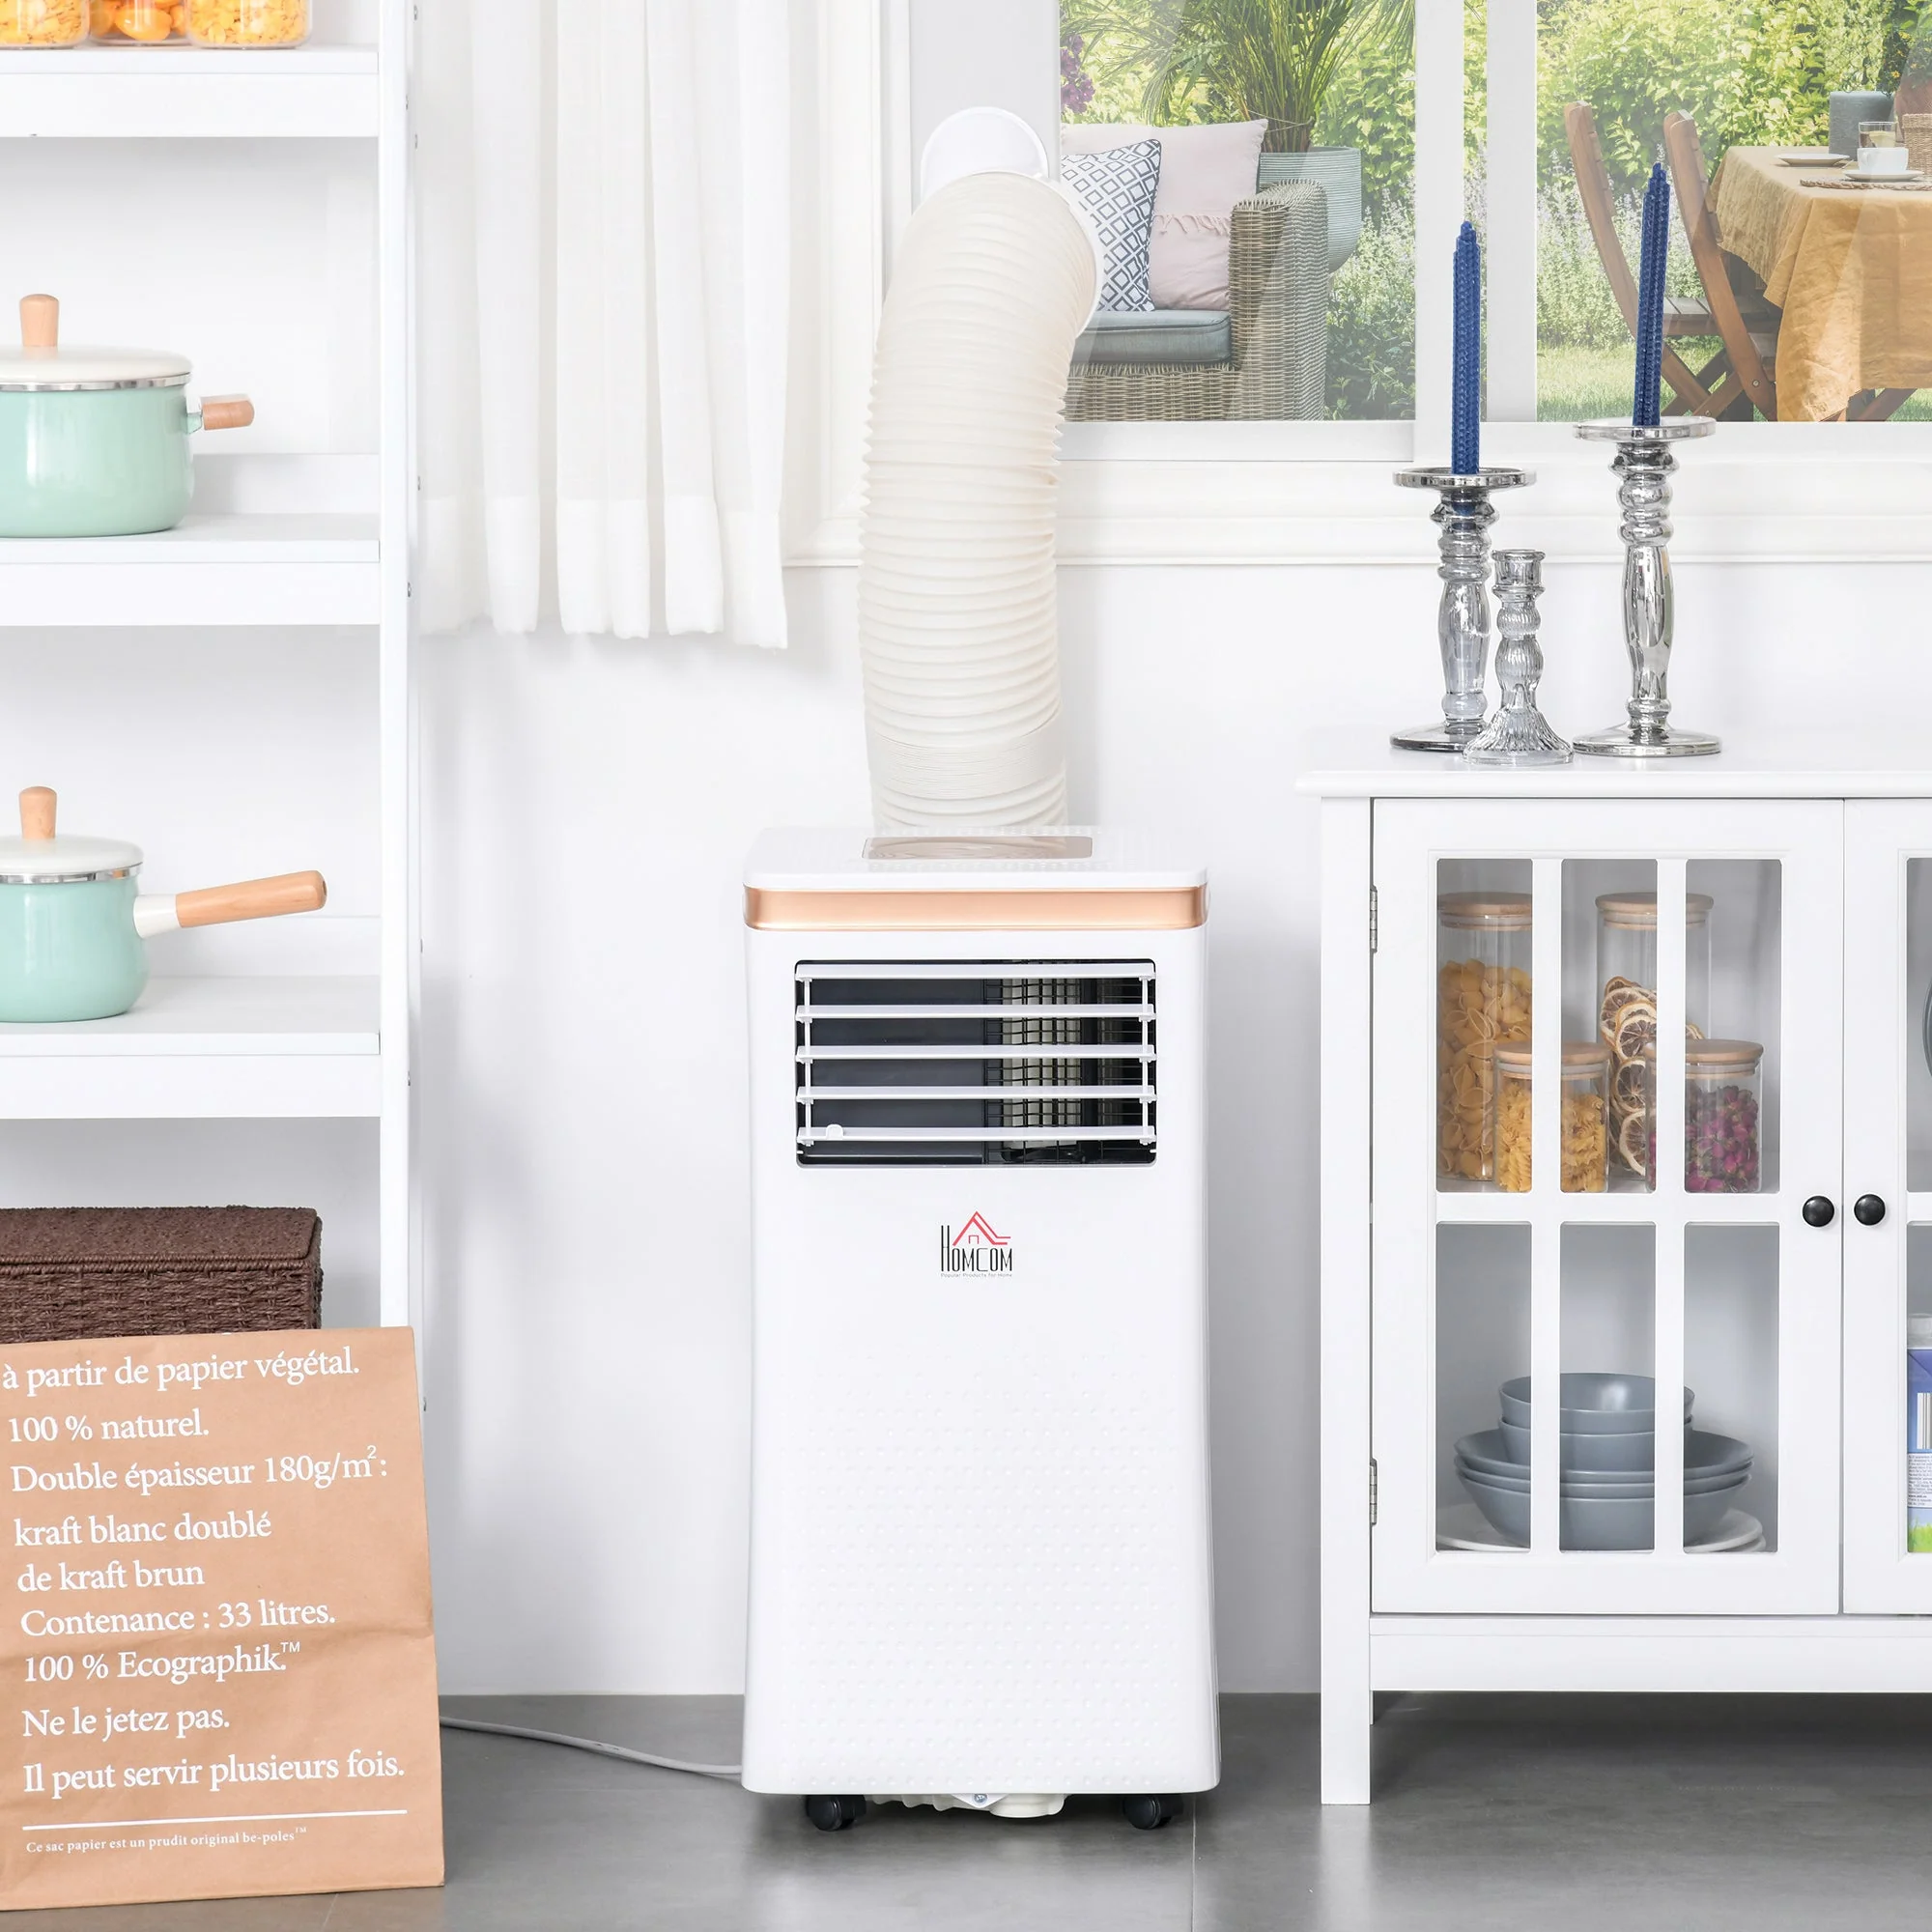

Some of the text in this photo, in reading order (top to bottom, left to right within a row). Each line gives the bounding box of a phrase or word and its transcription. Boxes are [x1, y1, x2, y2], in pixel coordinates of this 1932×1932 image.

[2, 1345, 360, 1398] à partir de papier végétal.
[9, 1407, 210, 1442] 100 % naturel.
[10, 1462, 118, 1492] Double
[125, 1461, 256, 1496] épaisseur
[14, 1509, 271, 1547] kraft blanc doublé
[16, 1559, 206, 1592] de kraft brun
[20, 1609, 195, 1636] Contenance
[217, 1602, 252, 1629] 33
[258, 1598, 336, 1627] litres.
[25, 1655, 73, 1682] 100
[82, 1654, 109, 1680] %
[21, 1706, 230, 1743] Ne le jetez pas.
[23, 1747, 405, 1800] Il peut servir plusieurs fois.
[26, 1842, 43, 1853] Ce
[45, 1842, 65, 1852] sac
[67, 1839, 107, 1854] papier
[109, 1839, 128, 1849] est
[129, 1839, 146, 1848] un
[148, 1834, 188, 1850] prudit
[190, 1832, 241, 1847] original
